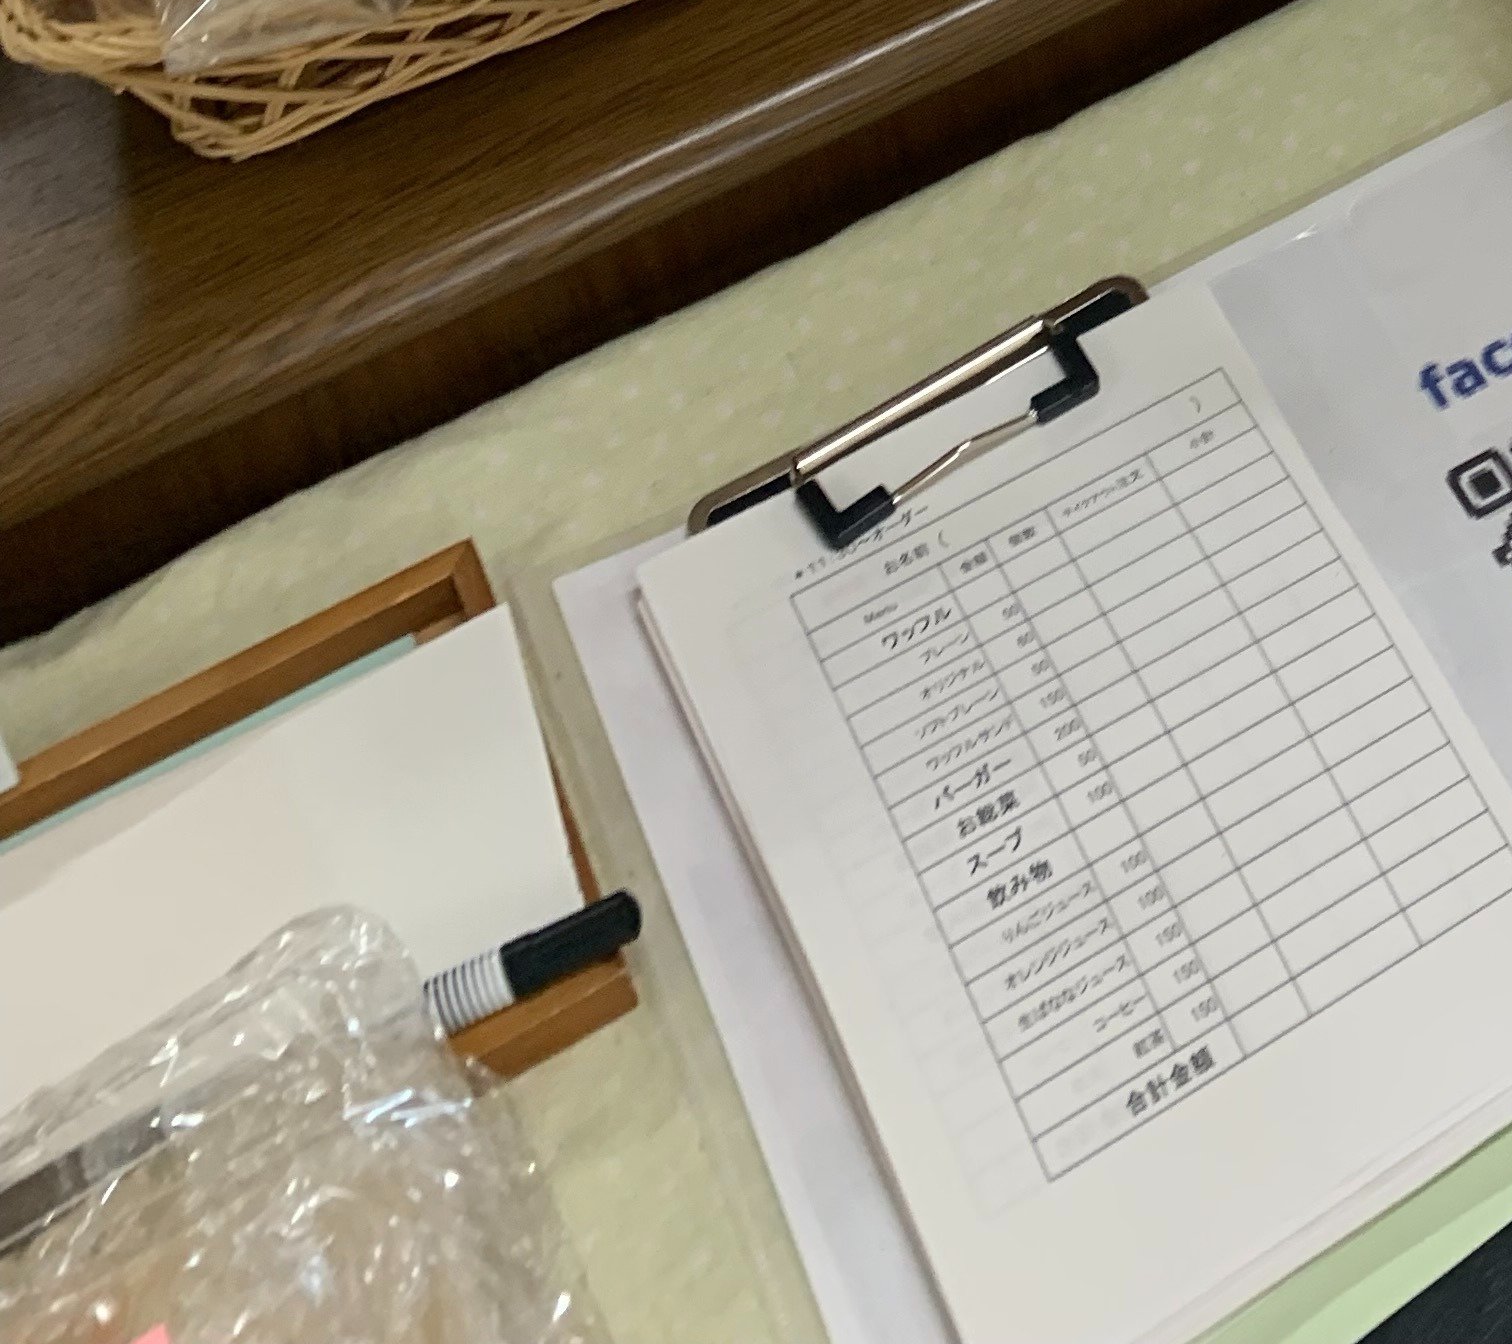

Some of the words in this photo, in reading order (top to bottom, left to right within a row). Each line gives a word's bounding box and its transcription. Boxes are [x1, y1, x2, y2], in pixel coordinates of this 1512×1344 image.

[881, 606, 952, 650] ワッフル
[934, 758, 1012, 810] バーガー
[966, 826, 1023, 876] スープ
[986, 859, 1054, 910] 飲み物
[1001, 879, 1097, 943] りんごジュース
[1093, 991, 1149, 1033] コーヒー
[1125, 1045, 1216, 1117] 合計金額
